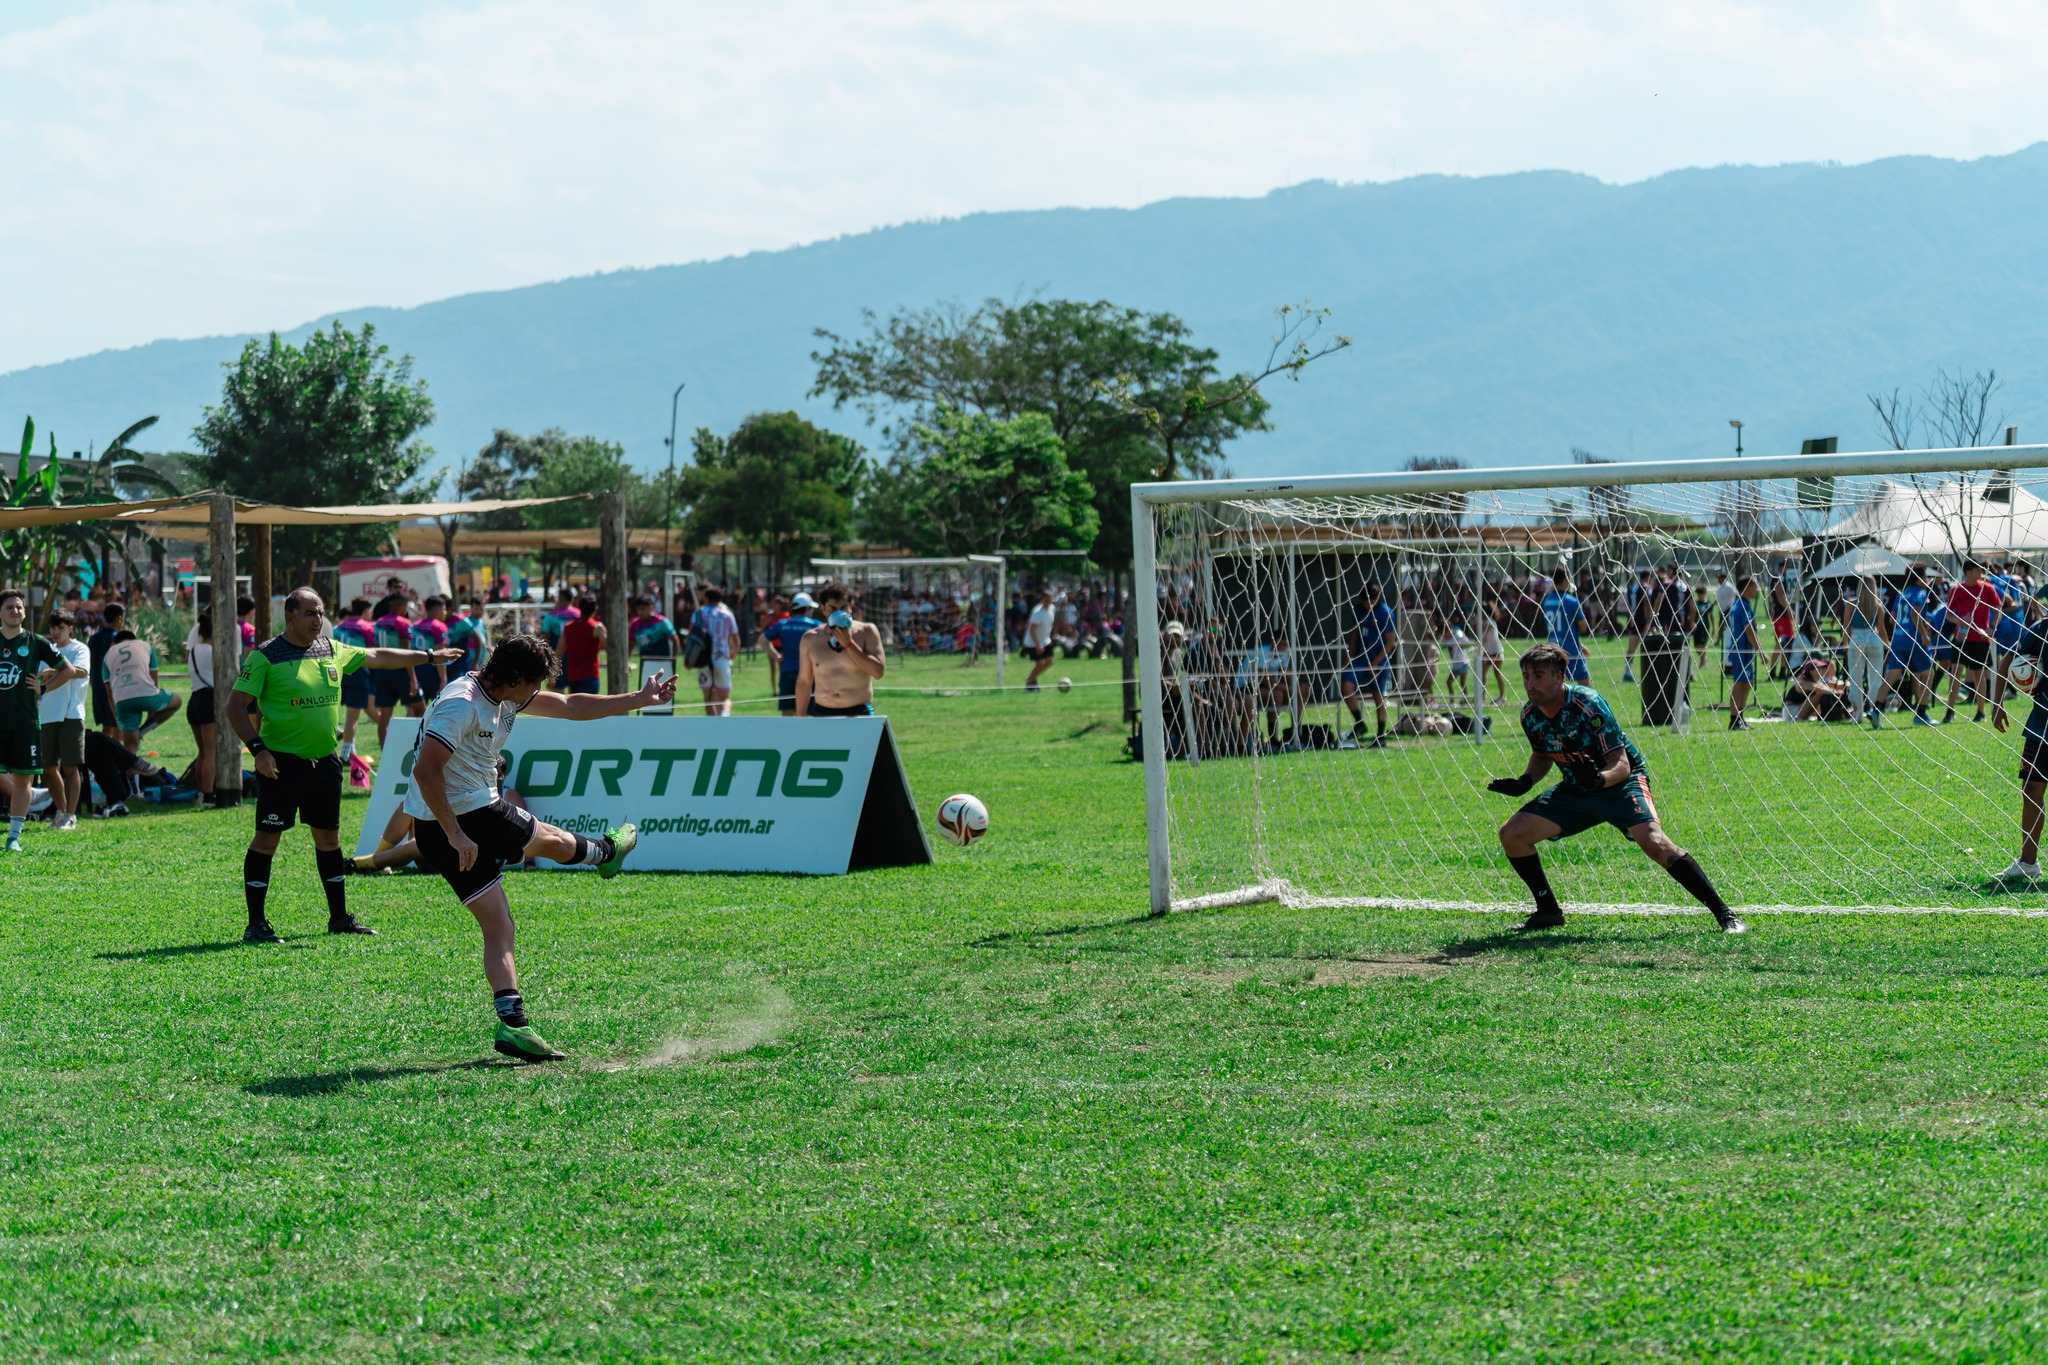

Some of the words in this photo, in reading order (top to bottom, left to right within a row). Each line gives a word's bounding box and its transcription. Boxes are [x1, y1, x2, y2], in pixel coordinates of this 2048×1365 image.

[118, 645, 132, 664] 5
[394, 749, 850, 798] ORTING
[639, 813, 775, 836] sporting.com.ar
